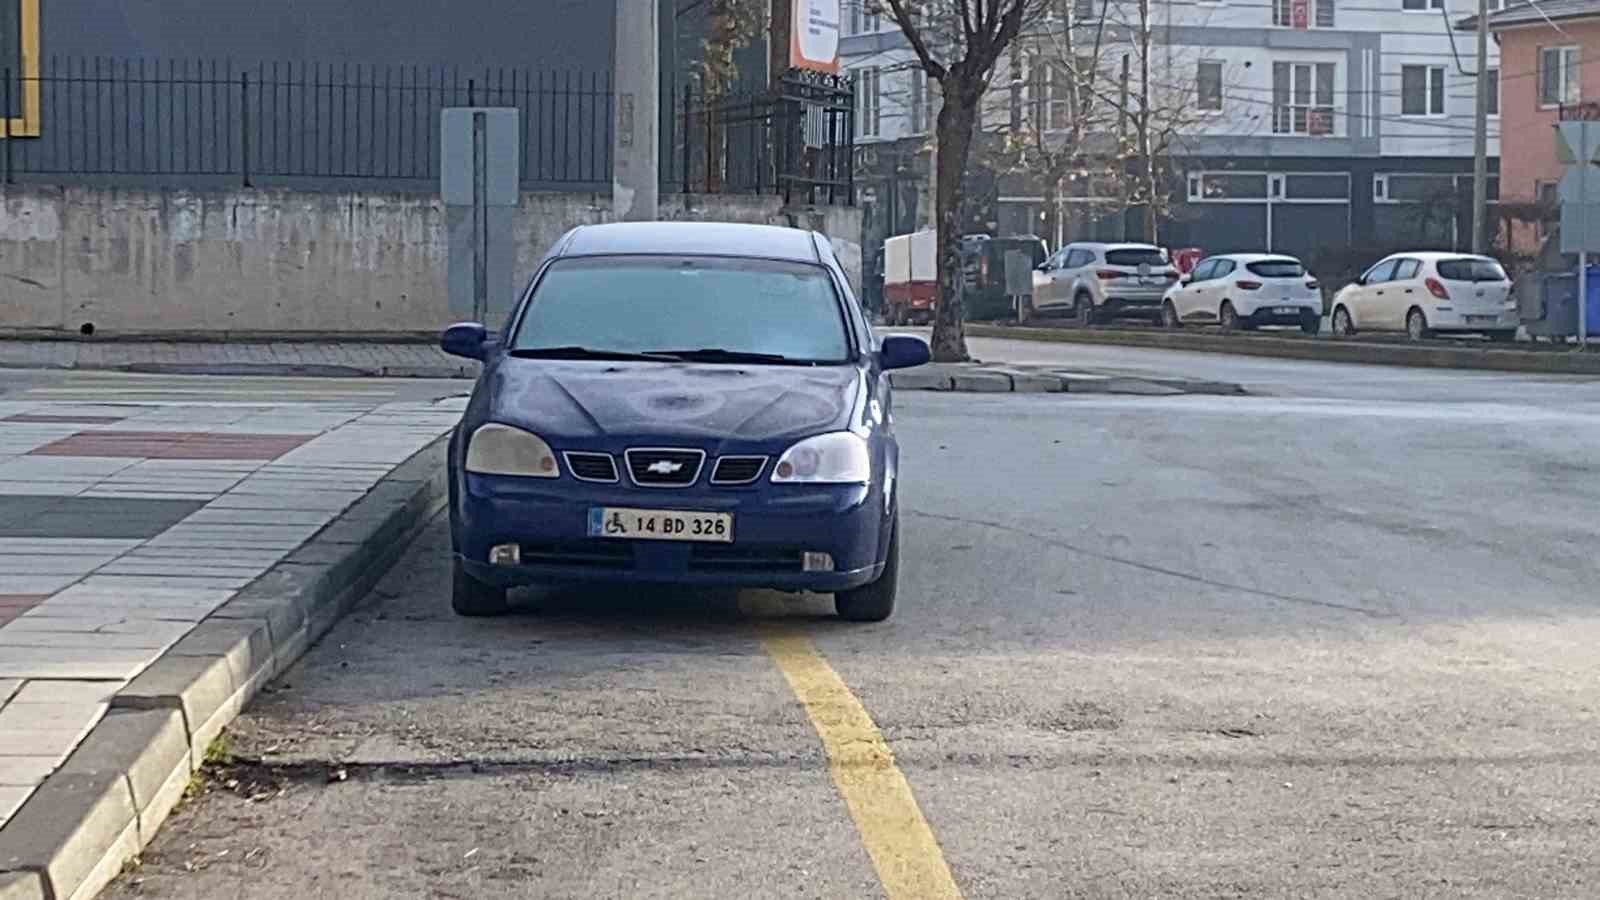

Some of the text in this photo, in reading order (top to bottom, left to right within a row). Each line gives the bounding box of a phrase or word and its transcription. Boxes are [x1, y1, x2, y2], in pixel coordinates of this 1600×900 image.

[637, 517, 725, 535] 14 BD 326
